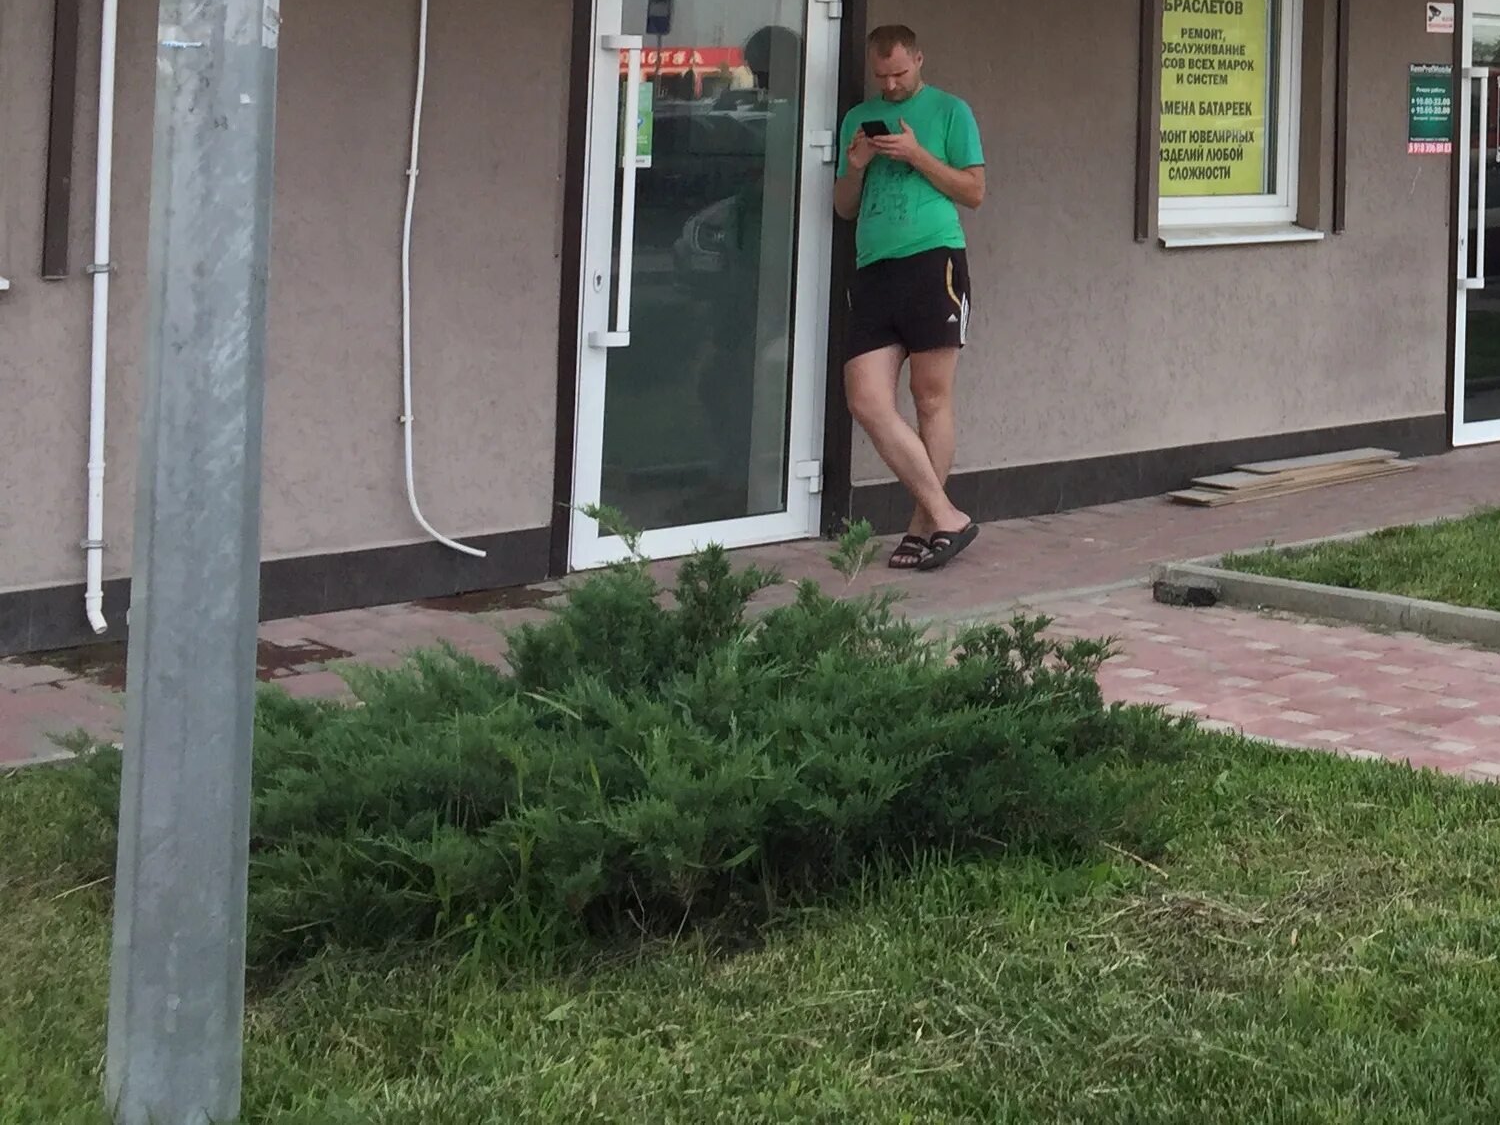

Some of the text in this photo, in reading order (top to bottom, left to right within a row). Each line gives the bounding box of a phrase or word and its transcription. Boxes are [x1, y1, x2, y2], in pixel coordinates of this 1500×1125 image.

[1180, 27, 1226, 43] РЕМОНТ,
[1188, 58, 1215, 71] ВСЕХ
[1217, 59, 1255, 72] МАРОК
[1176, 72, 1228, 85] И СИСТЕМ
[1198, 100, 1252, 116] БАТАРЕЕК
[1189, 130, 1255, 144] ЮВЕЛИРНЫХ
[1206, 143, 1243, 161] ЛЮБОЙ
[1168, 166, 1231, 181] СЛОЖНОСТИ
